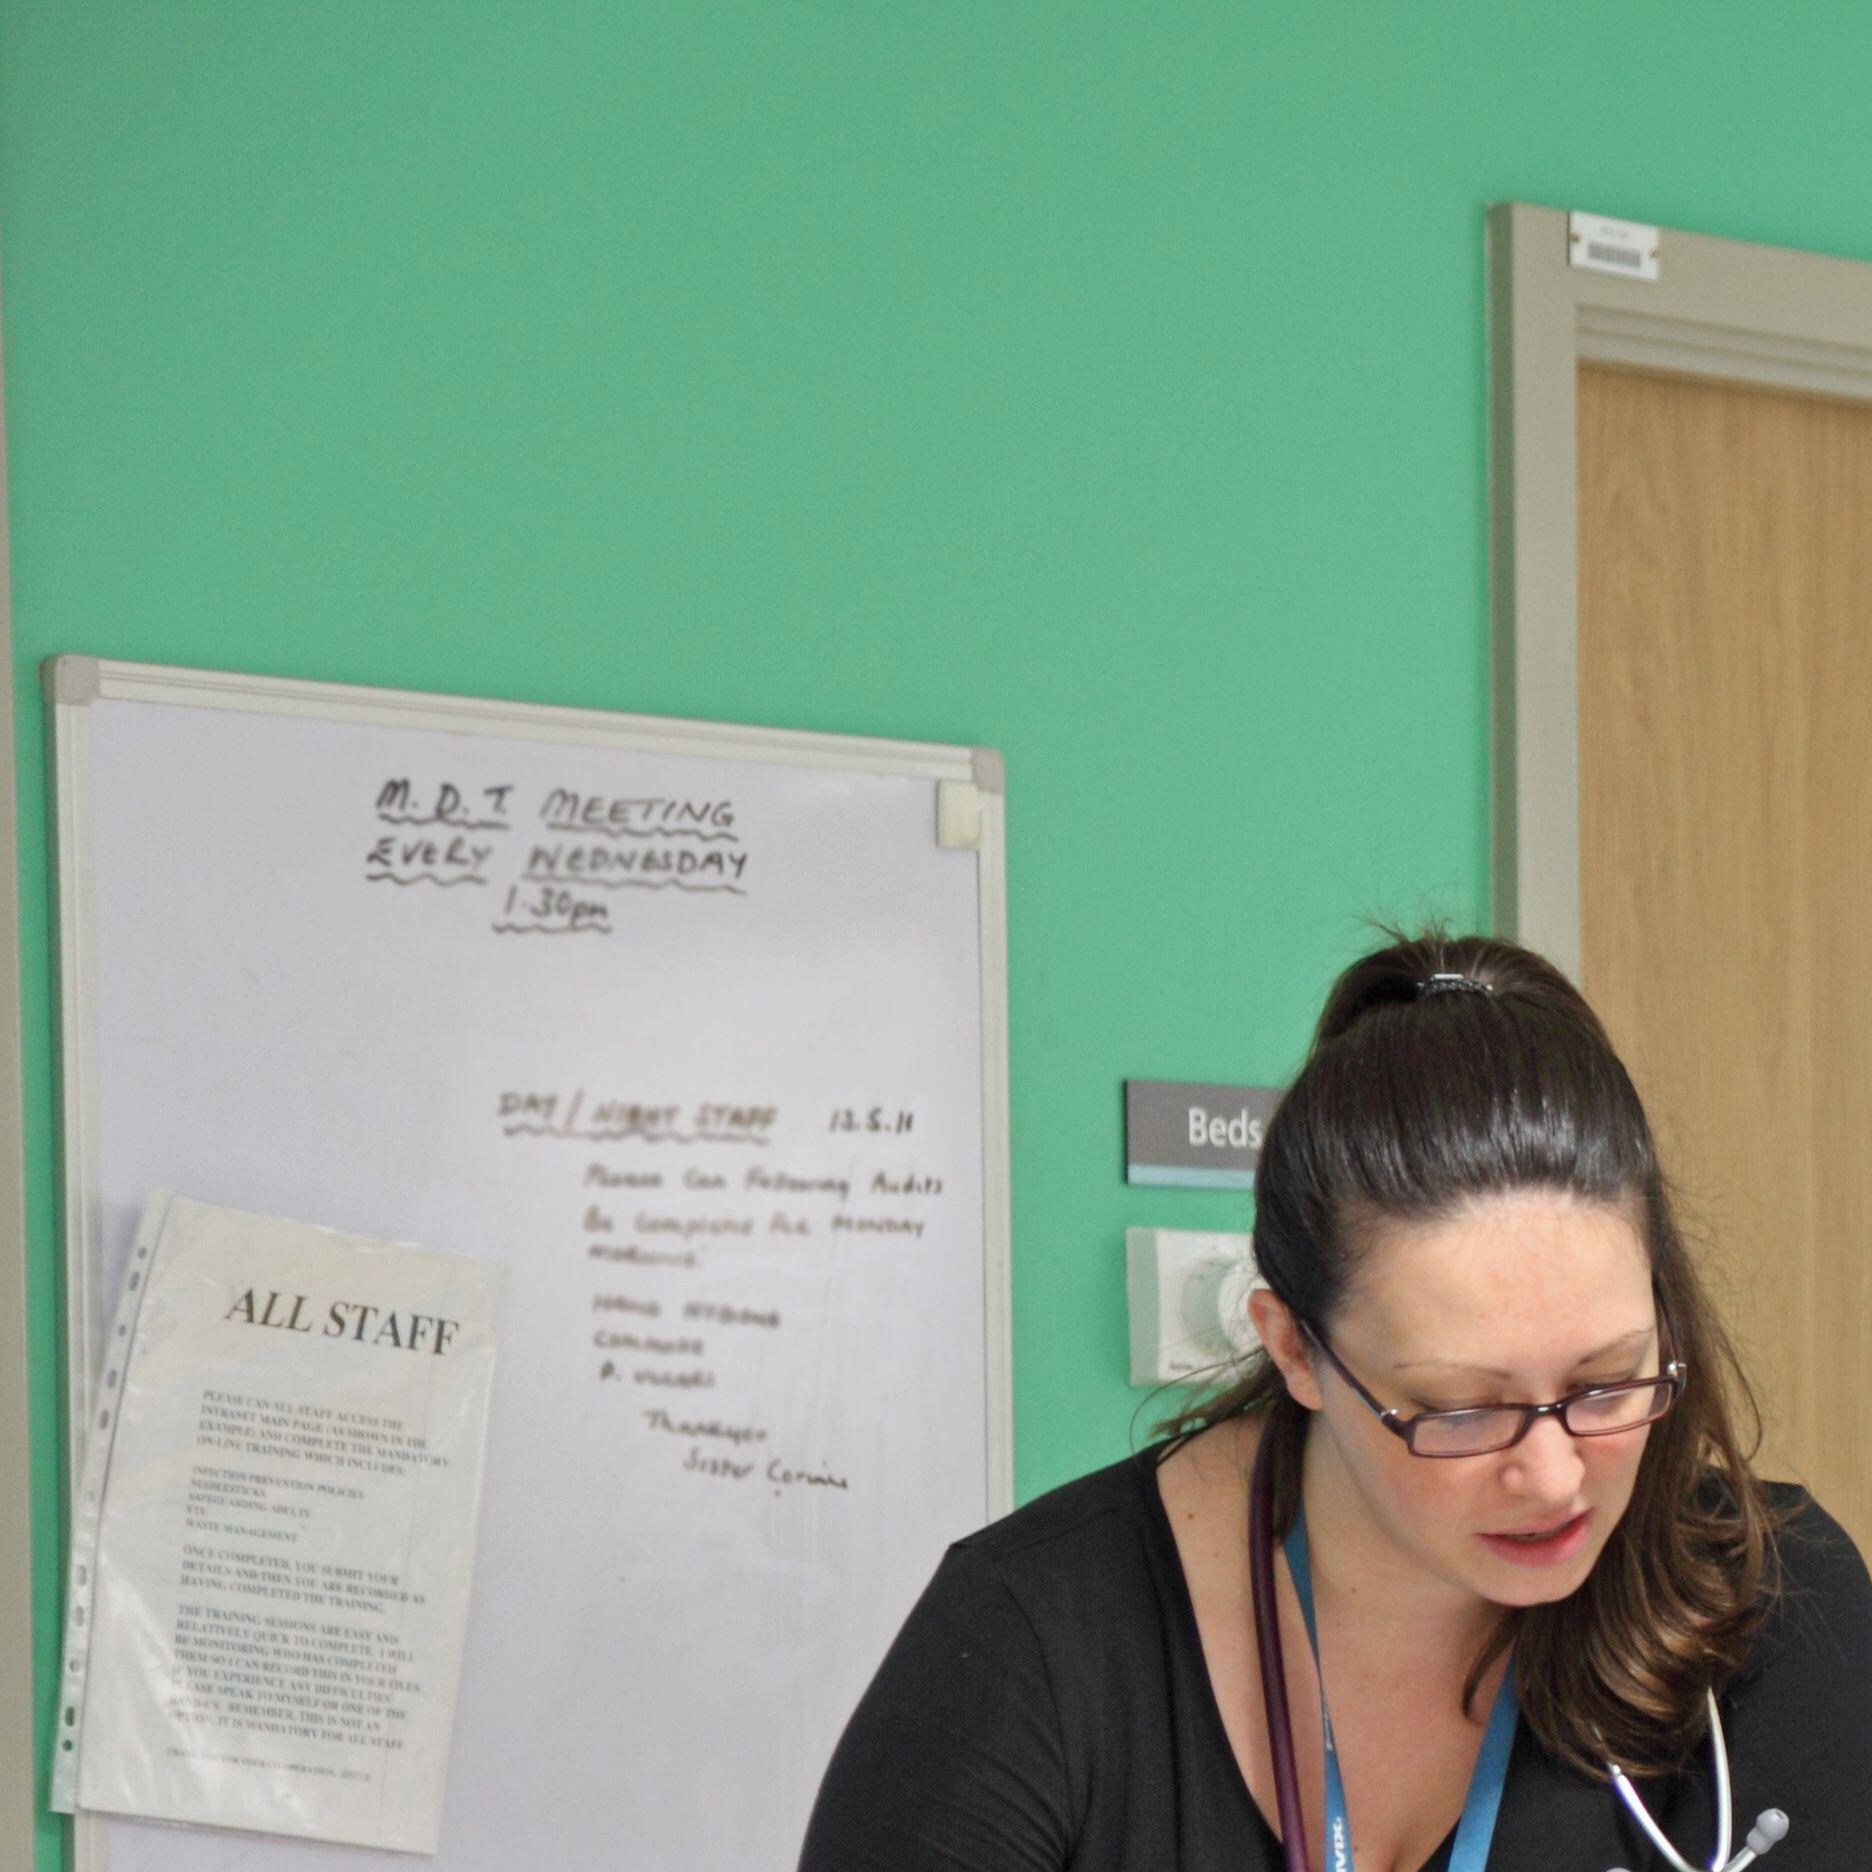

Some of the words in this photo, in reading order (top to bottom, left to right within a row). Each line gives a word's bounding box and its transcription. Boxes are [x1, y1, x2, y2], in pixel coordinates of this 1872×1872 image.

[539, 789, 735, 827] MEETING
[367, 837, 492, 868] EVERY
[528, 845, 748, 878] WEDNESDAY
[224, 1286, 312, 1334] ALL
[322, 1301, 460, 1357] STAFF
[297, 1405, 332, 1418] STAFF
